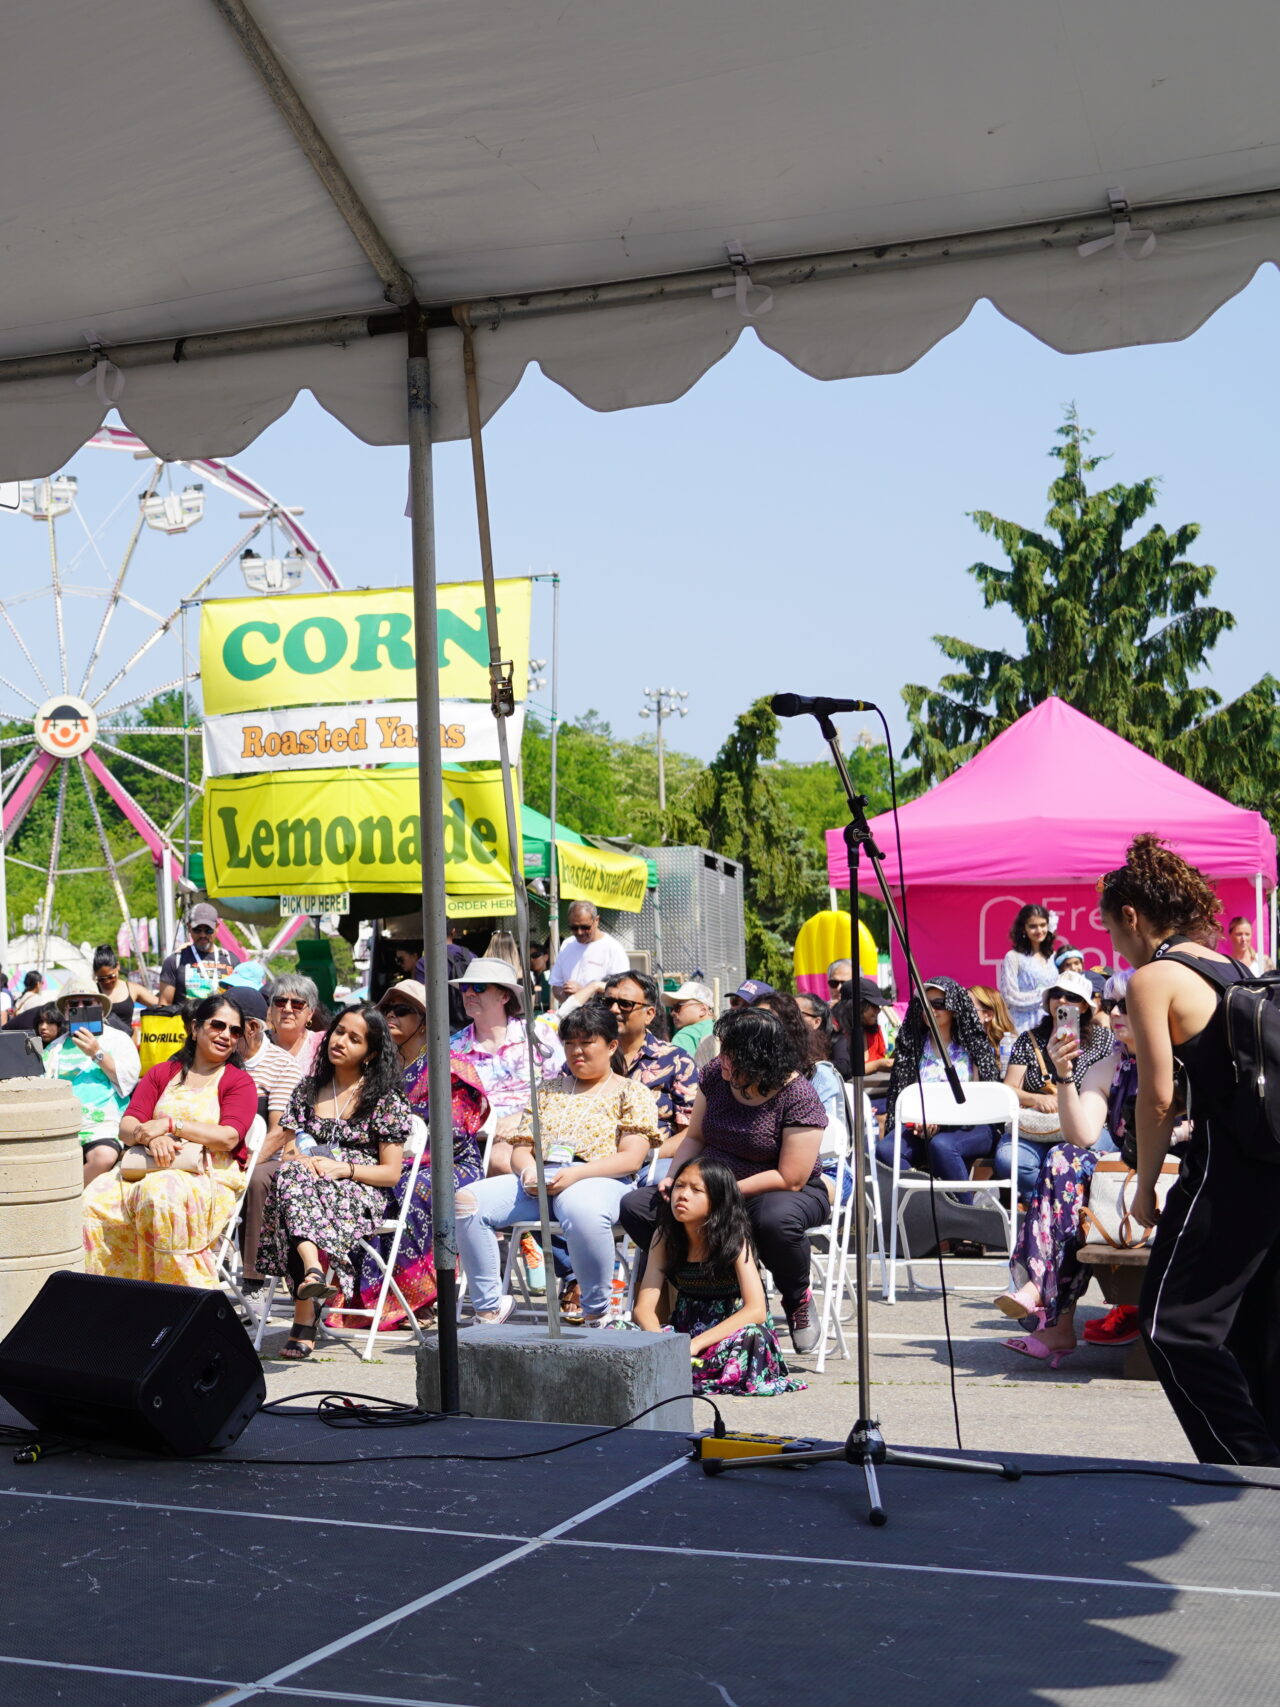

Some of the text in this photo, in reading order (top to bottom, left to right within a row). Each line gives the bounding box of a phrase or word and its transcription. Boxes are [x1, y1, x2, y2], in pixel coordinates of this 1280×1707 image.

[222, 607, 500, 681] CORN
[241, 717, 368, 758] Roasted
[218, 797, 498, 869] Lemonade
[621, 869, 645, 899] Corn
[282, 895, 342, 914] PICK UP HERE
[447, 899, 517, 911] ORDER HER
